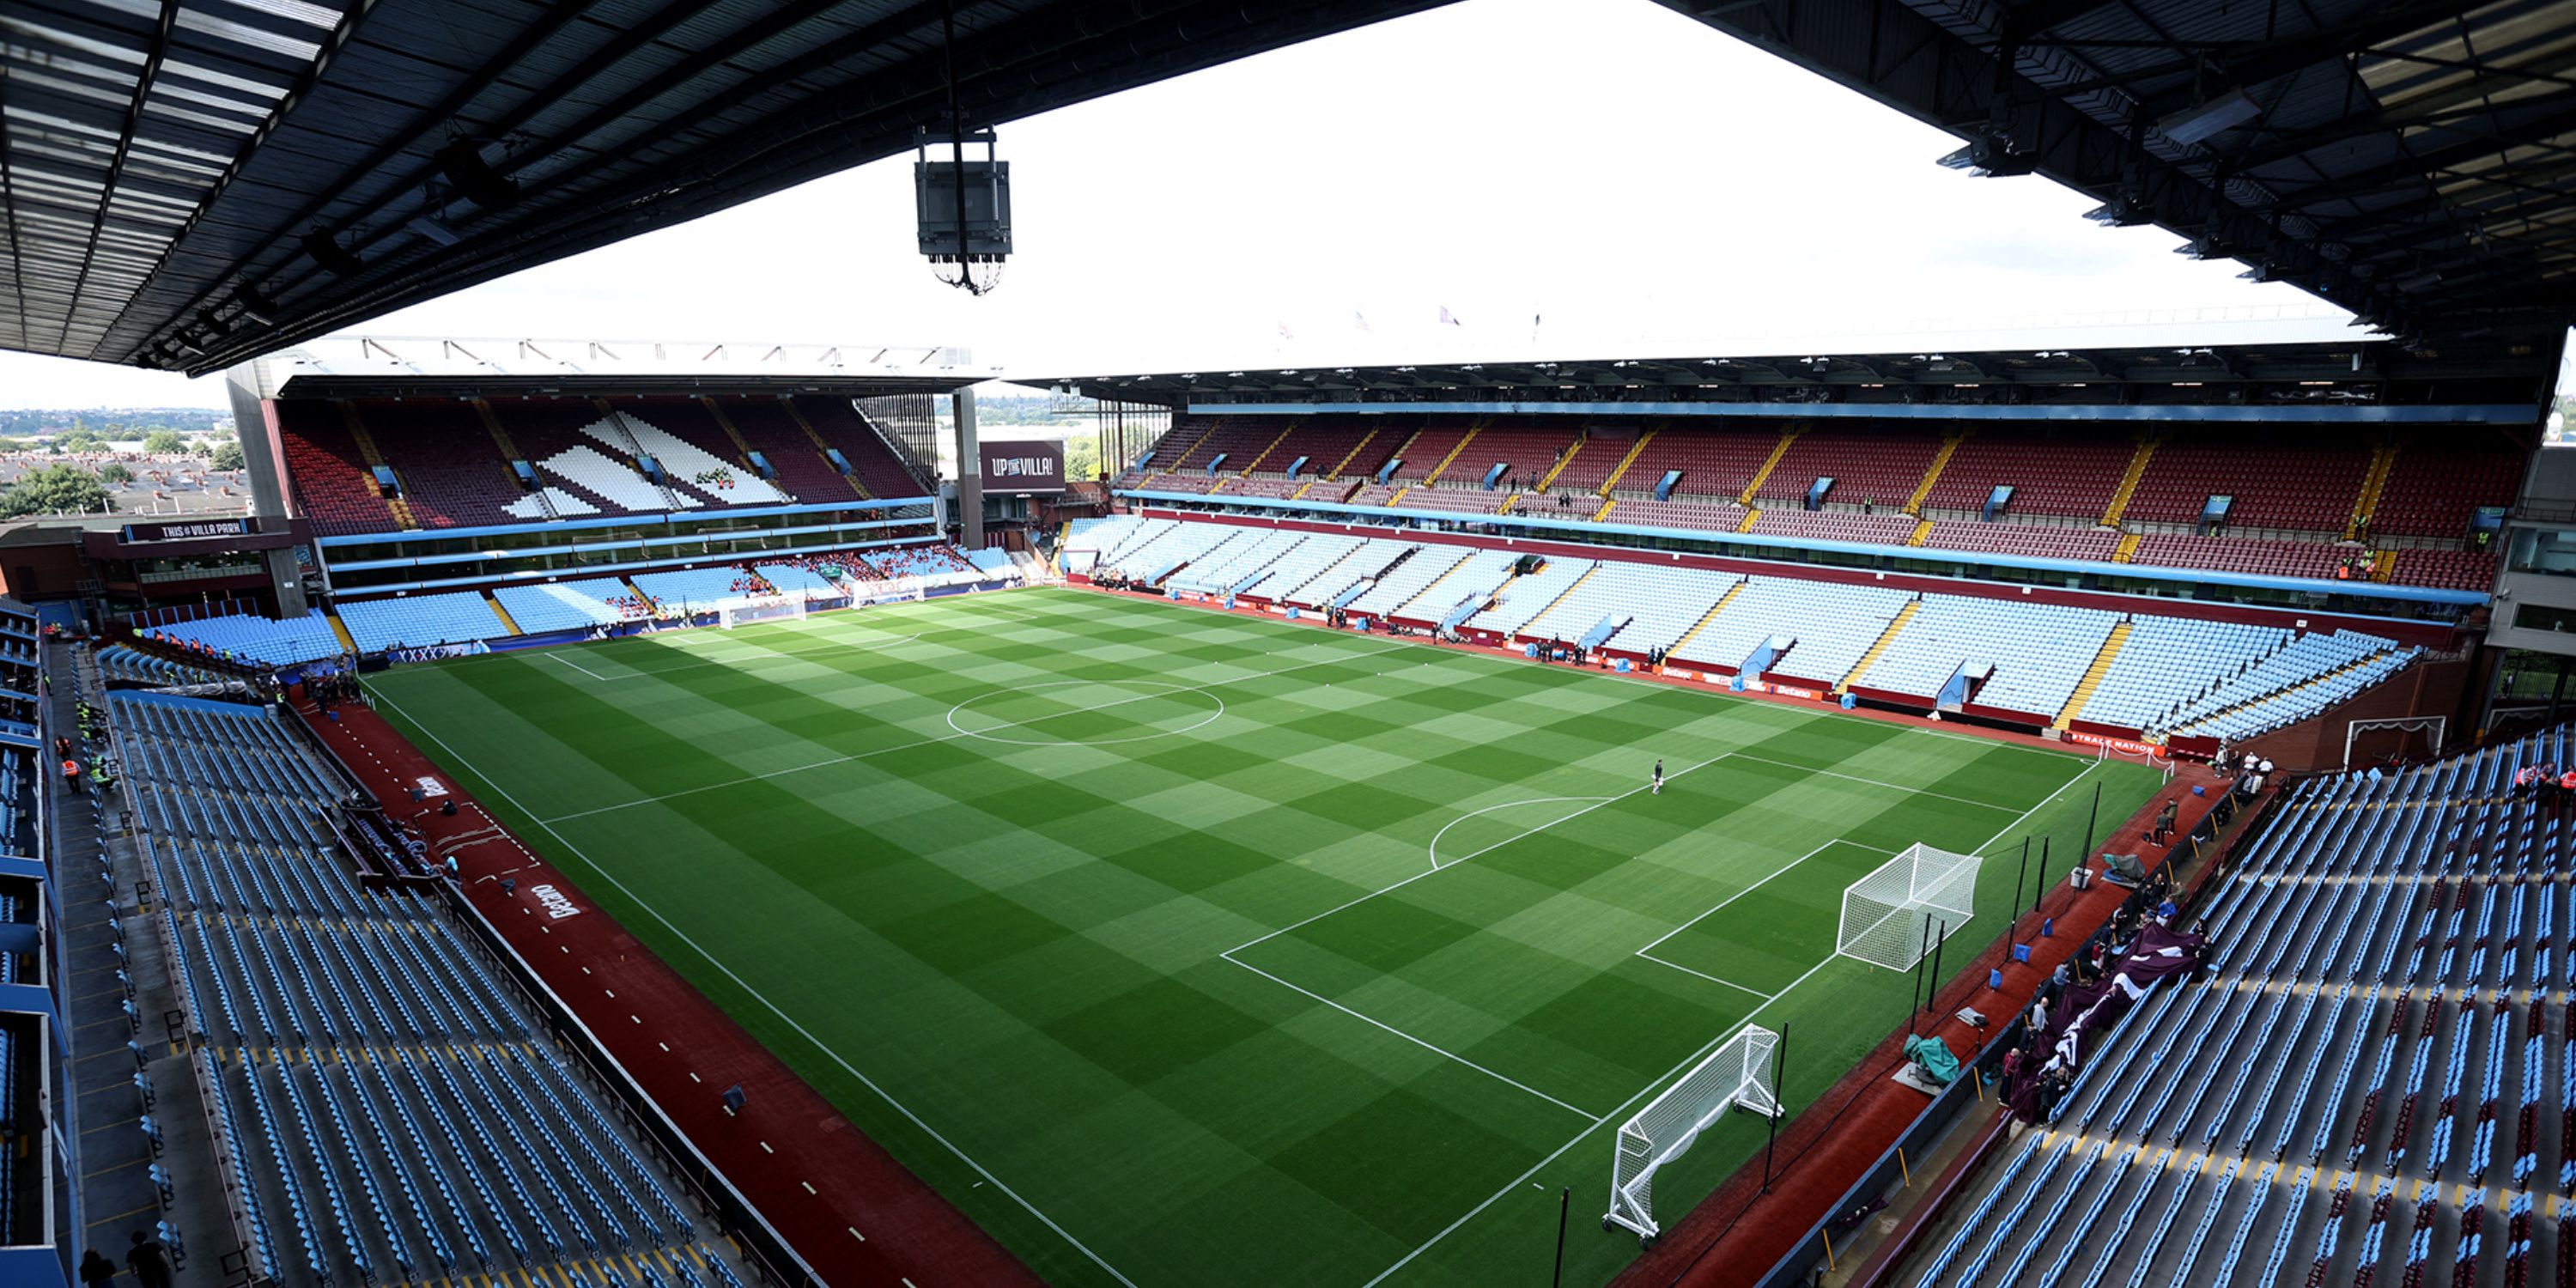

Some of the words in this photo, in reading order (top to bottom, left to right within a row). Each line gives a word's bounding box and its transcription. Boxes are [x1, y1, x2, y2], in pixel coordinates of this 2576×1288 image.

[992, 458, 1008, 477] UP
[1020, 457, 1054, 476] VILLA!
[161, 526, 184, 538] THIS
[191, 524, 216, 537] VILLA
[216, 522, 240, 534] PARK
[1777, 684, 1811, 698] Betano
[2115, 741, 2155, 753] NATION
[532, 884, 581, 920] Betano
